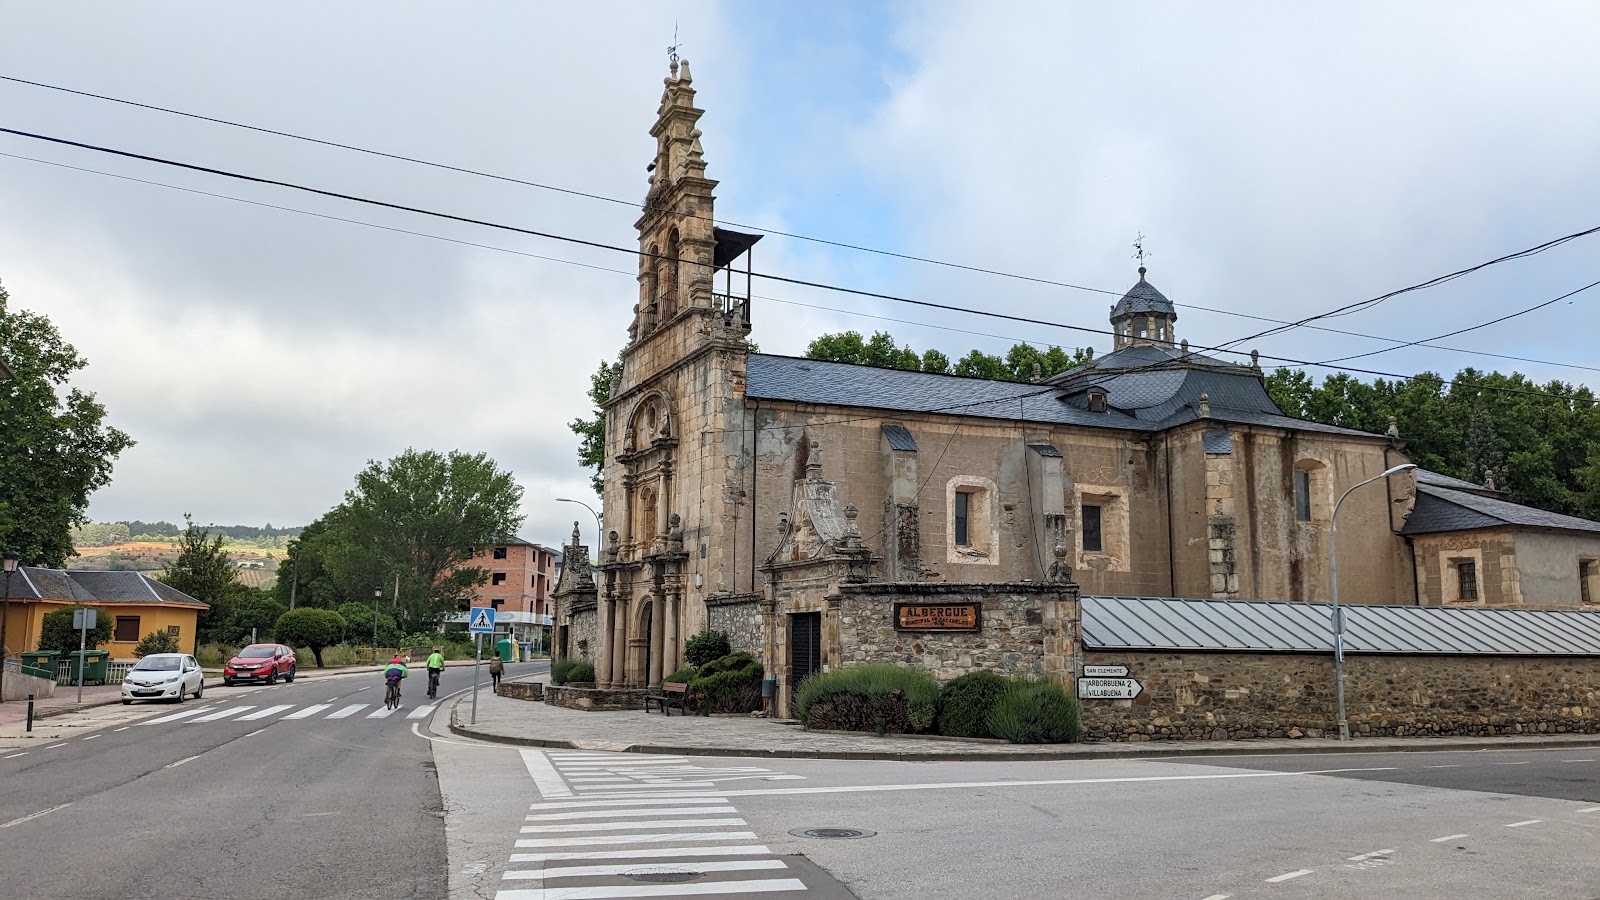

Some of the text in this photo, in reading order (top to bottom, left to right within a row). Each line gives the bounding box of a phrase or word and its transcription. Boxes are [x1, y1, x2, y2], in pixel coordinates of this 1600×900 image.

[906, 607, 968, 617] ALBERGUE
[1127, 680, 1132, 688] 2
[1088, 689, 1132, 697] VILLABUENA 4
